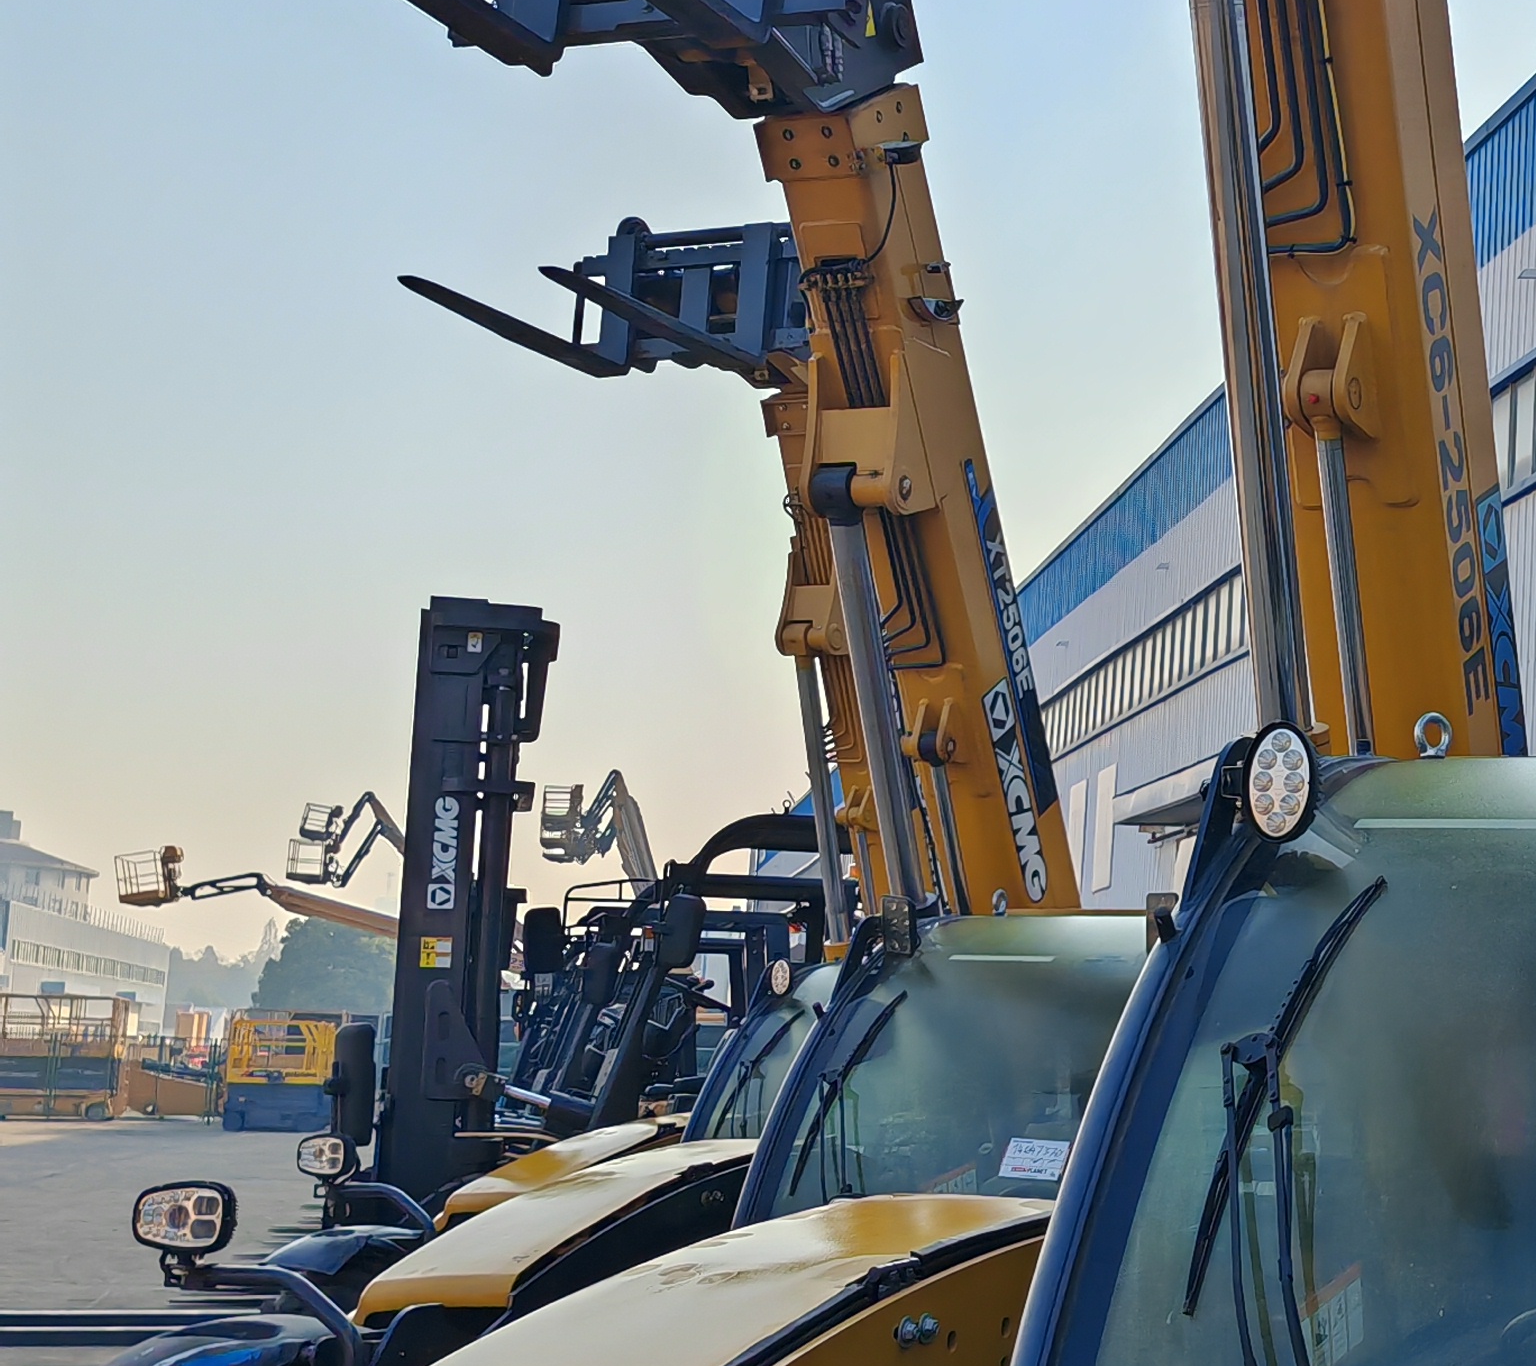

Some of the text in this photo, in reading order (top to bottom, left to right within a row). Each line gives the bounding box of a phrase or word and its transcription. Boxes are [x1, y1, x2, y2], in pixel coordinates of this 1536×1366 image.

[1412, 206, 1490, 716] XC6-2506E
[986, 531, 1034, 699] XT2506E
[1486, 581, 1526, 756] XCM
[431, 796, 460, 883] XCMG
[996, 742, 1046, 903] XCMG
